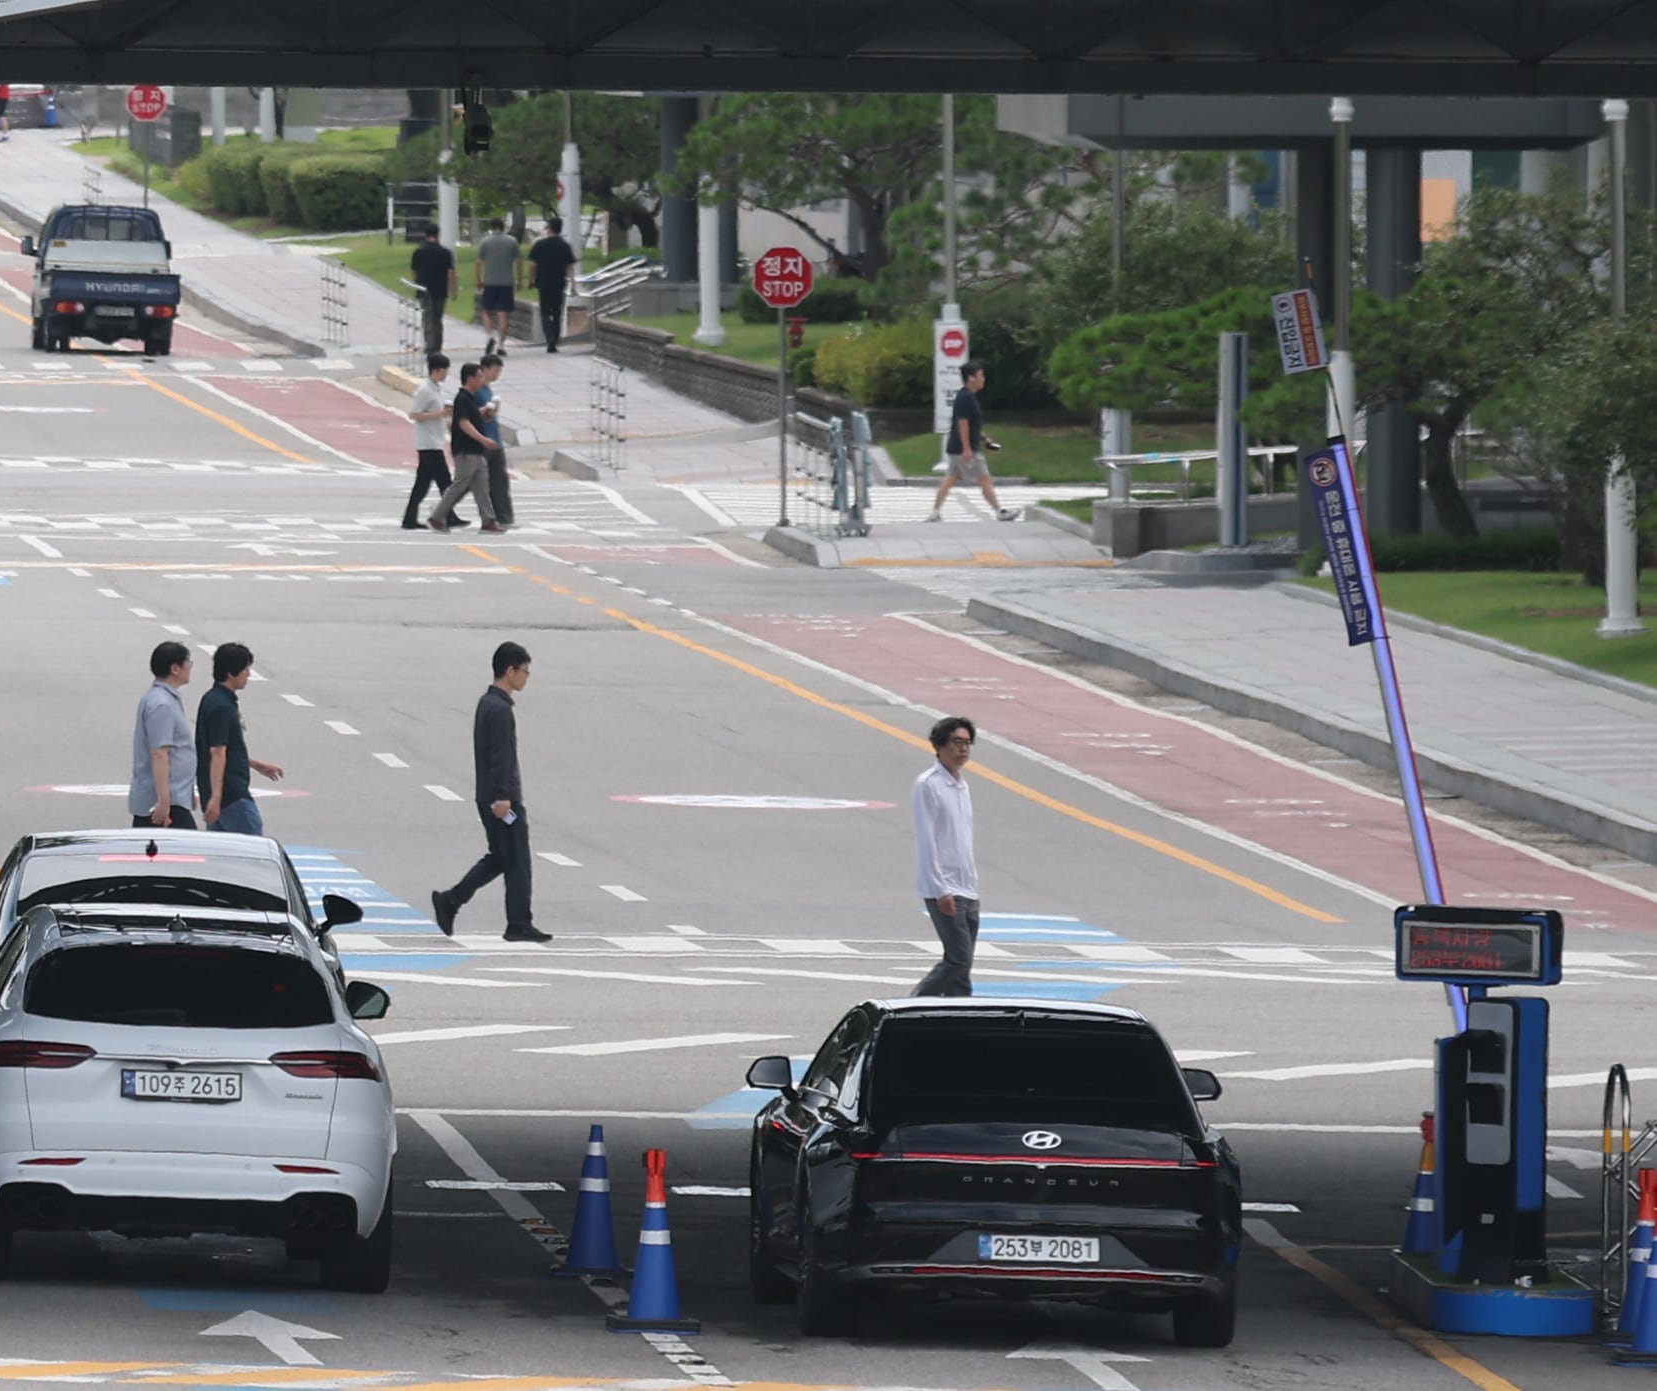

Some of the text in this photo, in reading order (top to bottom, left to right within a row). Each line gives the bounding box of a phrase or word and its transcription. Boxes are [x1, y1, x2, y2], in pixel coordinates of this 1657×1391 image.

[761, 255, 803, 277] 정지
[762, 280, 804, 297] STOP
[1279, 316, 1304, 368] 진입금지
[191, 1076, 235, 1096] 2615
[962, 1175, 1119, 1187] GRANDEUR
[1048, 1239, 1093, 1259] 2081
